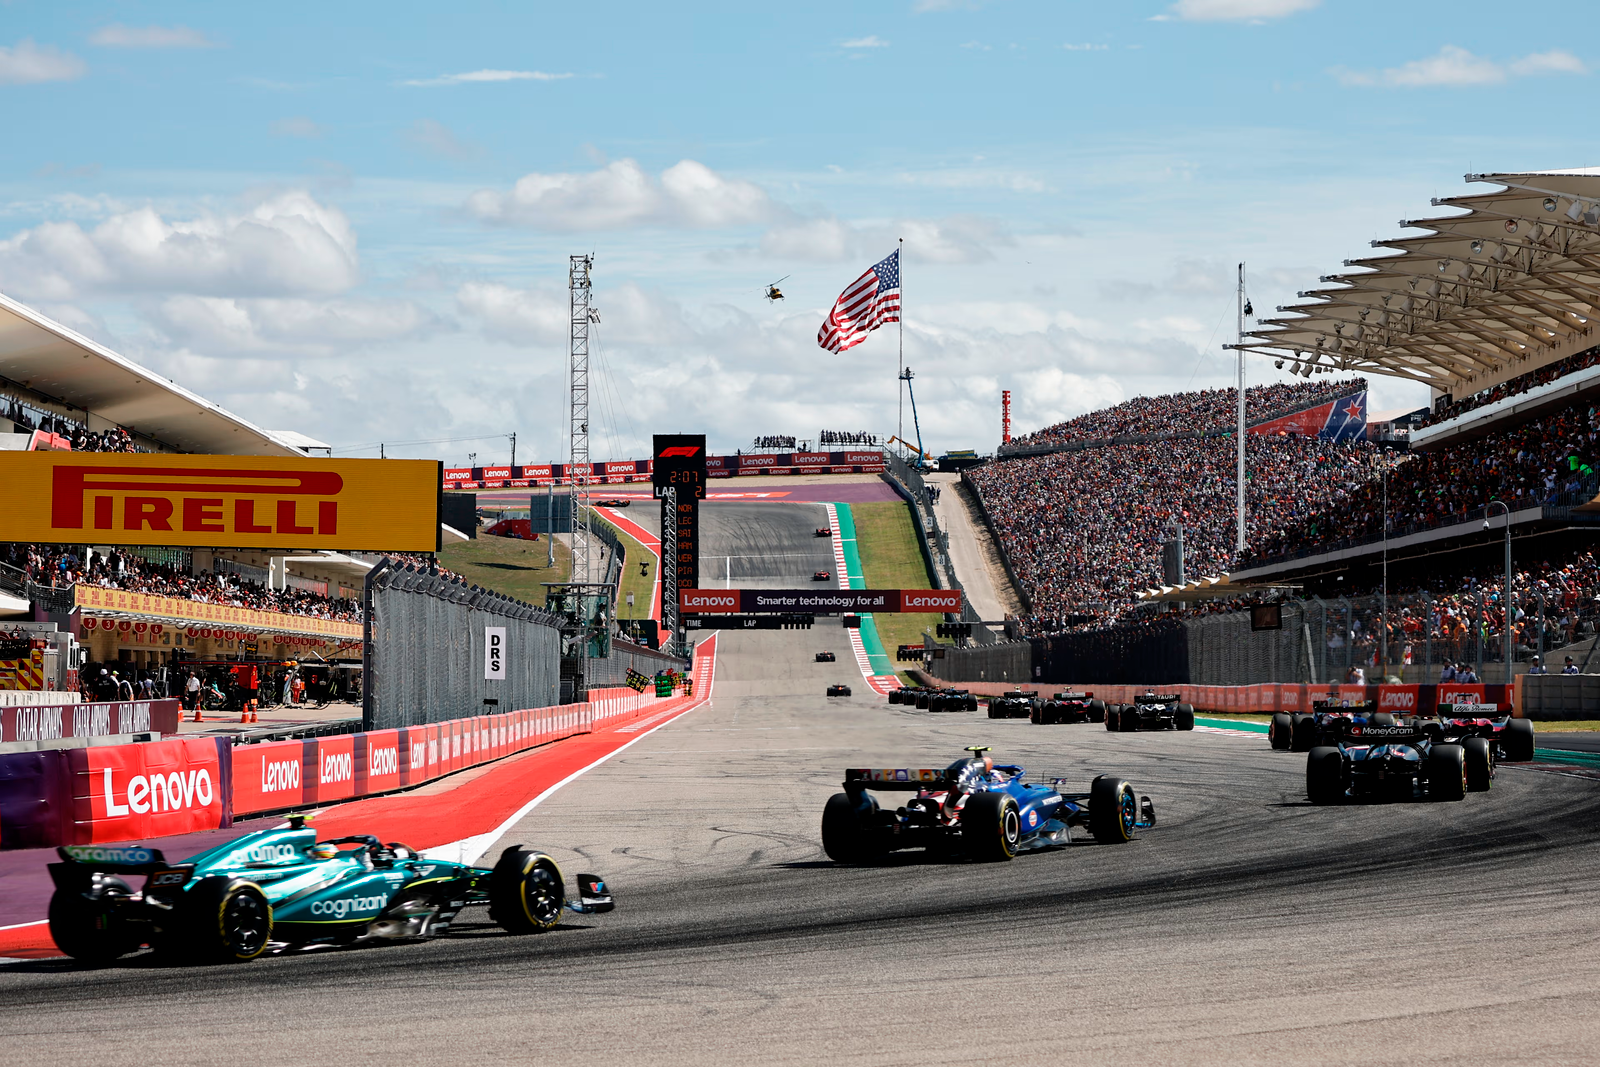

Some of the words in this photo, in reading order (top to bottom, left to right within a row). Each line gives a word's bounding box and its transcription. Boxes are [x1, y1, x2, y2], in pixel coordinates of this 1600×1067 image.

[742, 457, 774, 466] Lenovo
[795, 455, 827, 463] Lenovo
[847, 454, 880, 462] Lenovo
[524, 468, 550, 476] Lenovo
[607, 464, 634, 473] Lenovo
[445, 471, 471, 480] Lenovo
[484, 469, 510, 478] Lenovo
[670, 471, 698, 483] 2:07
[655, 486, 676, 497] LAP
[695, 486, 702, 497] 2
[51, 465, 344, 535] PIRELLI
[677, 504, 692, 512] NOR
[677, 517, 692, 525] LEC
[677, 529, 691, 537] SAI
[677, 542, 693, 550] HAM
[677, 554, 692, 562] VER
[677, 567, 692, 575] PIA
[684, 594, 735, 606] Lenovo
[756, 596, 797, 606] Smarter
[799, 595, 855, 607] technology
[857, 595, 872, 605] for
[872, 595, 885, 605] all
[905, 595, 956, 606] Lenovo
[88, 618, 93, 627] 2
[105, 620, 111, 629] 3
[122, 622, 127, 630] 4
[686, 619, 702, 627] TIME
[743, 619, 757, 627] LAP
[154, 625, 159, 633] 6
[191, 628, 196, 636] 7
[203, 629, 208, 637] 8
[227, 631, 234, 639] 10
[249, 633, 255, 641] 12
[490, 634, 501, 672] DRS
[1380, 689, 1414, 707] Lenovo
[16, 707, 39, 741] QATAR
[39, 706, 63, 740] AIRWAYS
[73, 705, 90, 738] QATAR
[90, 704, 111, 737] AIRWAYS
[118, 703, 133, 735] QATAR
[1362, 727, 1413, 736] MoneyGram
[369, 742, 397, 776] Lenovo
[320, 748, 352, 784] Lenovo
[262, 755, 300, 792] Lenovo
[103, 767, 213, 817] Lenovo
[71, 849, 150, 862] aramco
[153, 873, 184, 885] JCB
[310, 892, 388, 918] cognizant
